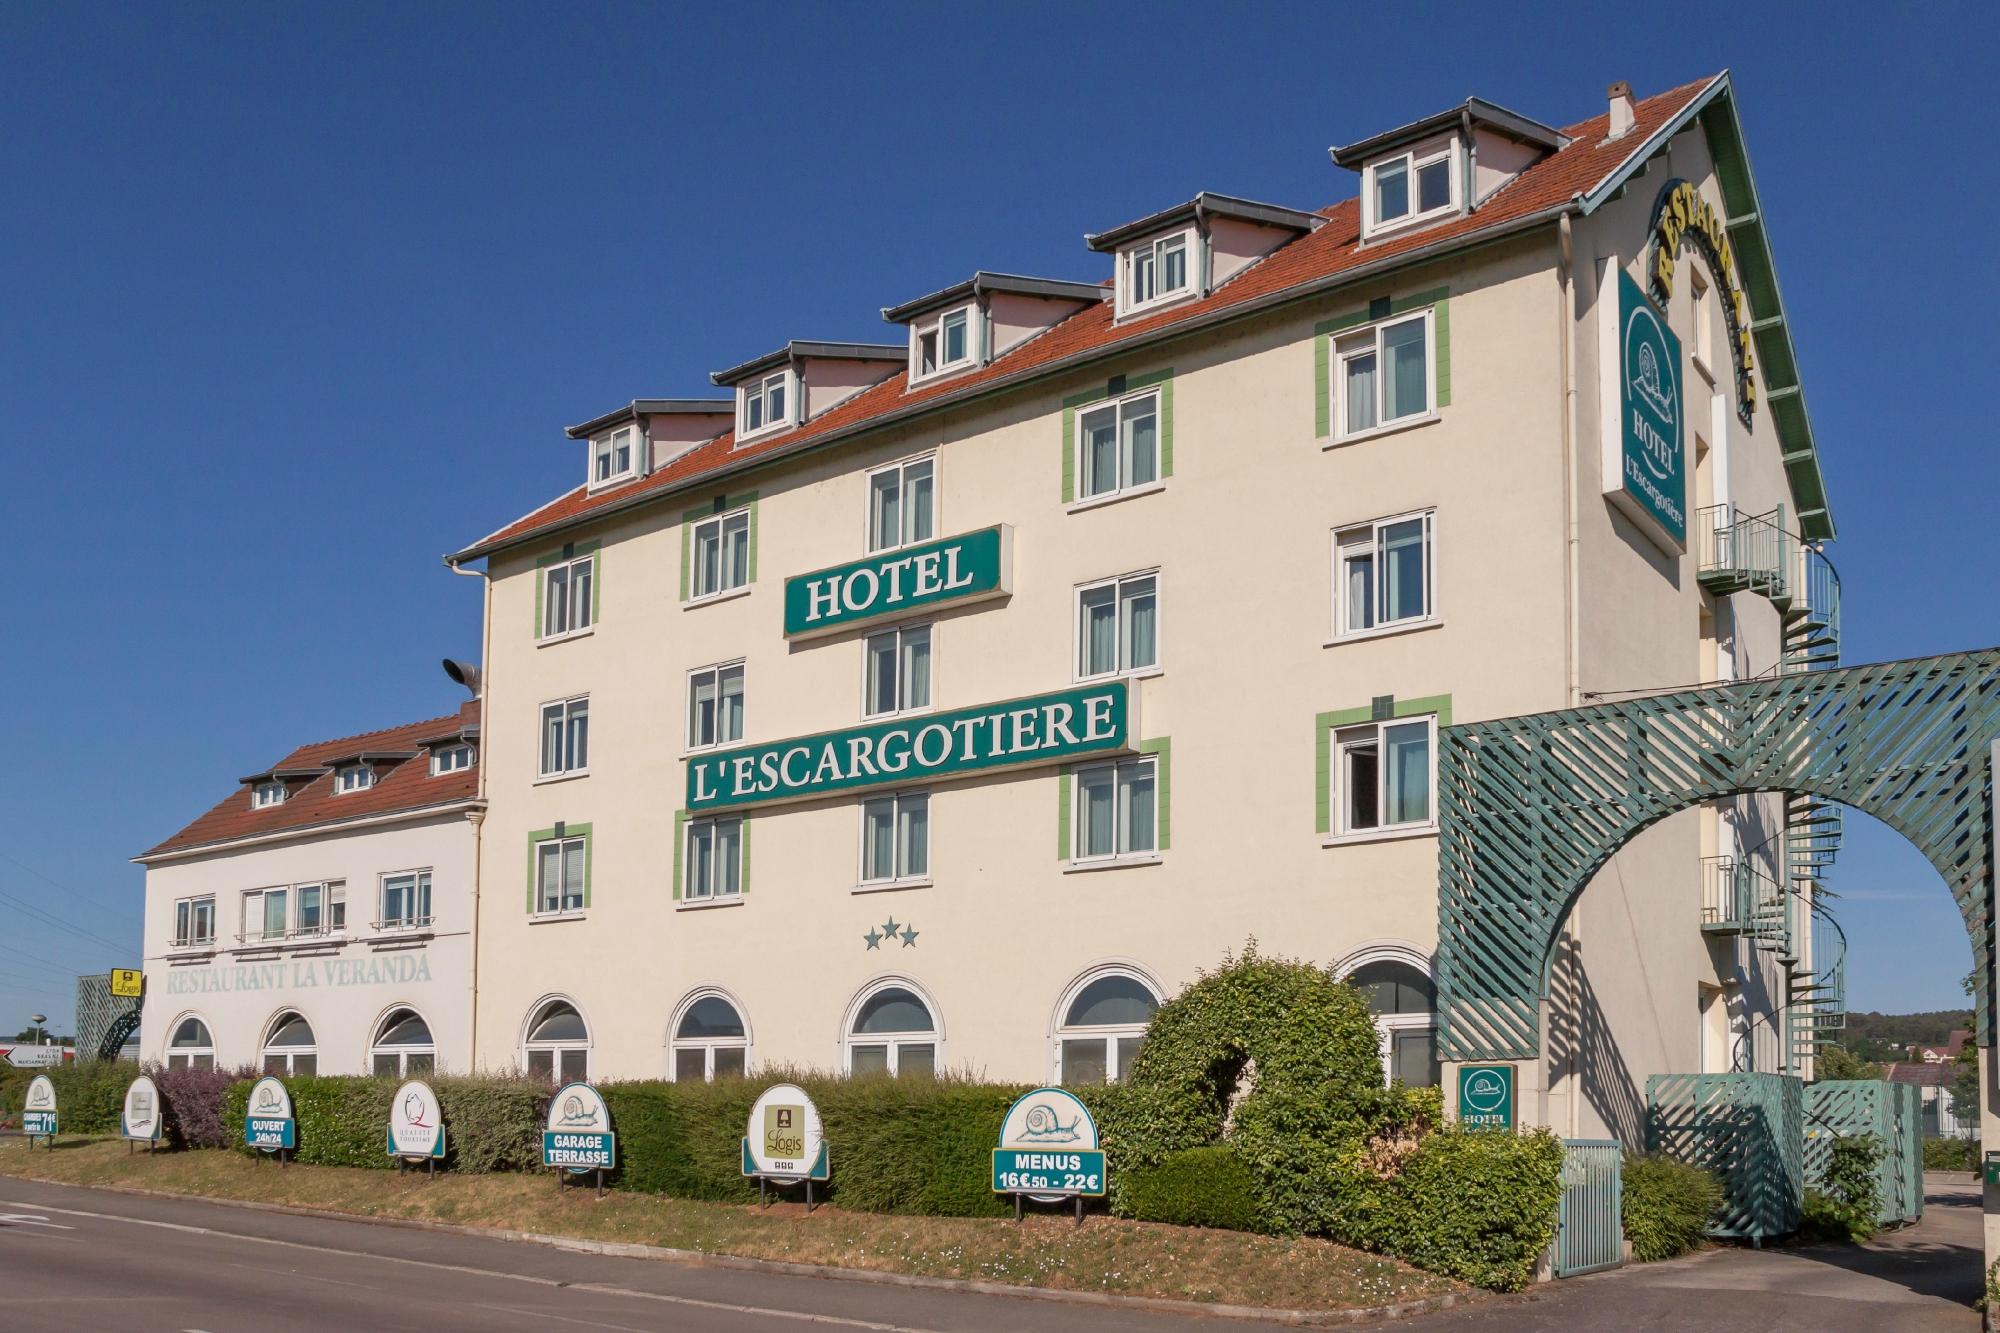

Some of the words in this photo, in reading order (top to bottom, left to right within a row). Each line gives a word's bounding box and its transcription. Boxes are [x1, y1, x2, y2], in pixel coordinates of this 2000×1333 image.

[1633, 407, 1675, 475] HOTEL
[1626, 453, 1683, 528] L'Escargotière
[805, 546, 974, 622] HOTEL
[693, 694, 1118, 803] L'ESCARGOTIERE
[166, 963, 287, 995] RESTAURANT
[292, 961, 317, 988] LA
[324, 953, 432, 986] VERANDA
[115, 981, 140, 995] Logis
[42, 1113, 56, 1132] 71€
[252, 1120, 285, 1131] OUVERT
[1463, 1113, 1506, 1125] HOTEL
[256, 1132, 281, 1143] 24h/24
[554, 1135, 602, 1149] GARAGE
[767, 1128, 802, 1156] Logis
[548, 1149, 609, 1164] TERRASSE
[1015, 1154, 1081, 1171] MENUS
[1064, 1173, 1099, 1190] 22€
